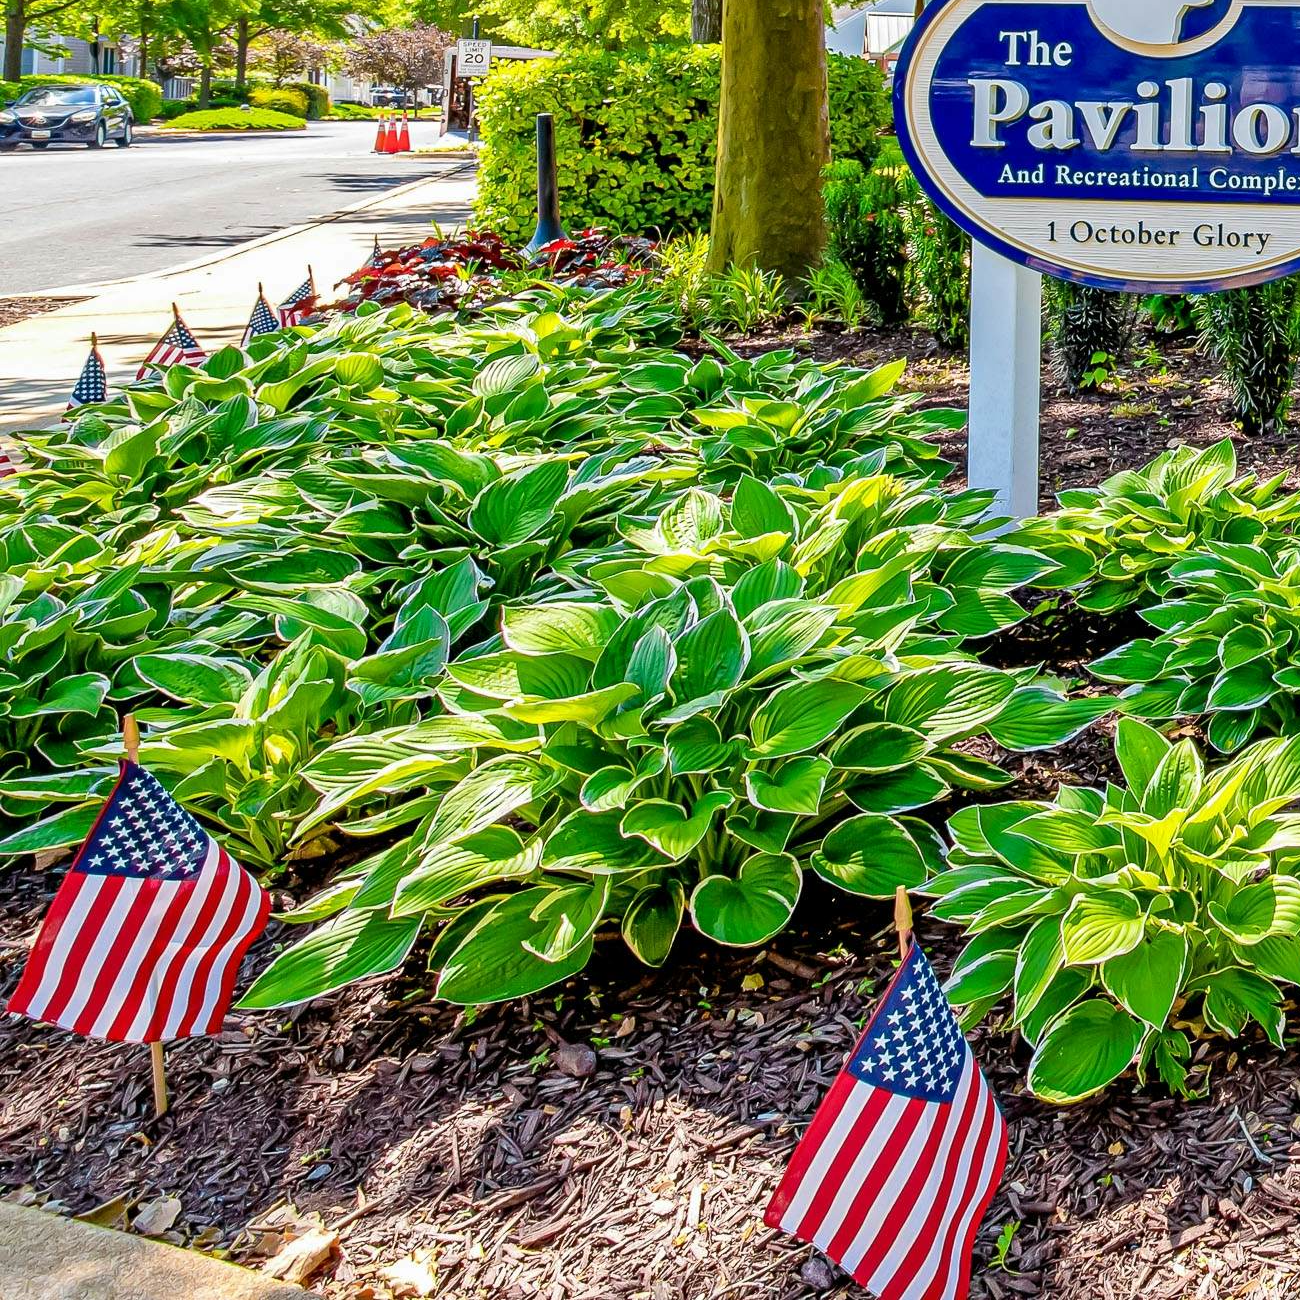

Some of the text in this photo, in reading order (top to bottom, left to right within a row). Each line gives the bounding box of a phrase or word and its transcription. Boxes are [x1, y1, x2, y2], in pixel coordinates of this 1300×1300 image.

[464, 54, 484, 63] 20
[999, 29, 1072, 67] The
[998, 164, 1044, 185] And
[1055, 165, 1199, 188] Recreational
[1047, 220, 1272, 255] 1 October Glory
